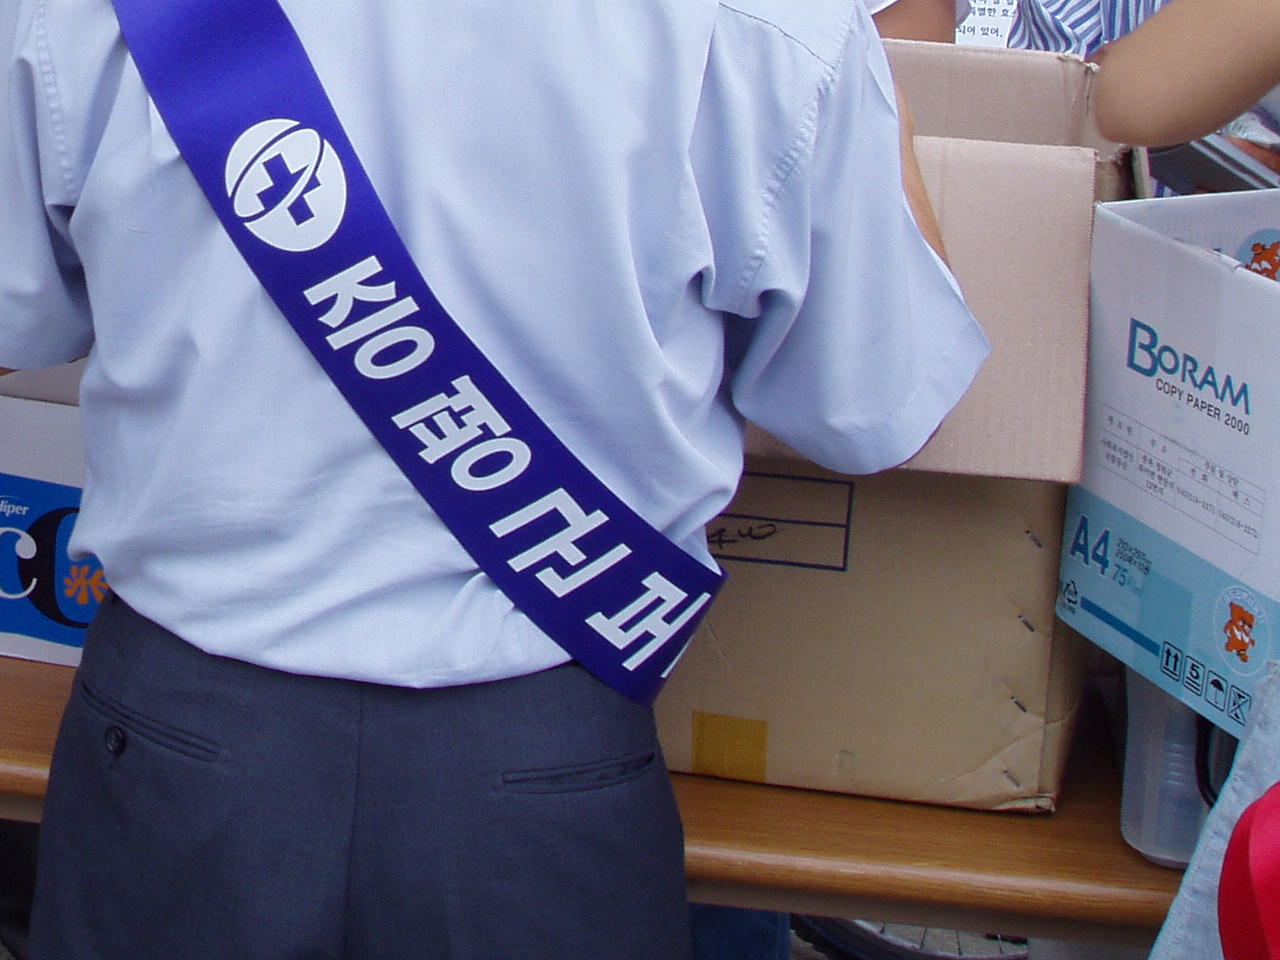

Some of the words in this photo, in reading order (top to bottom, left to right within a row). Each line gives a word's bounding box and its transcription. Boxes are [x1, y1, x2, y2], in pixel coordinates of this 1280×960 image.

[1155, 378, 1185, 402] COPY
[1186, 393, 1222, 423] PAPER
[1224, 412, 1251, 436] 2000
[1070, 515, 1111, 576] A4
